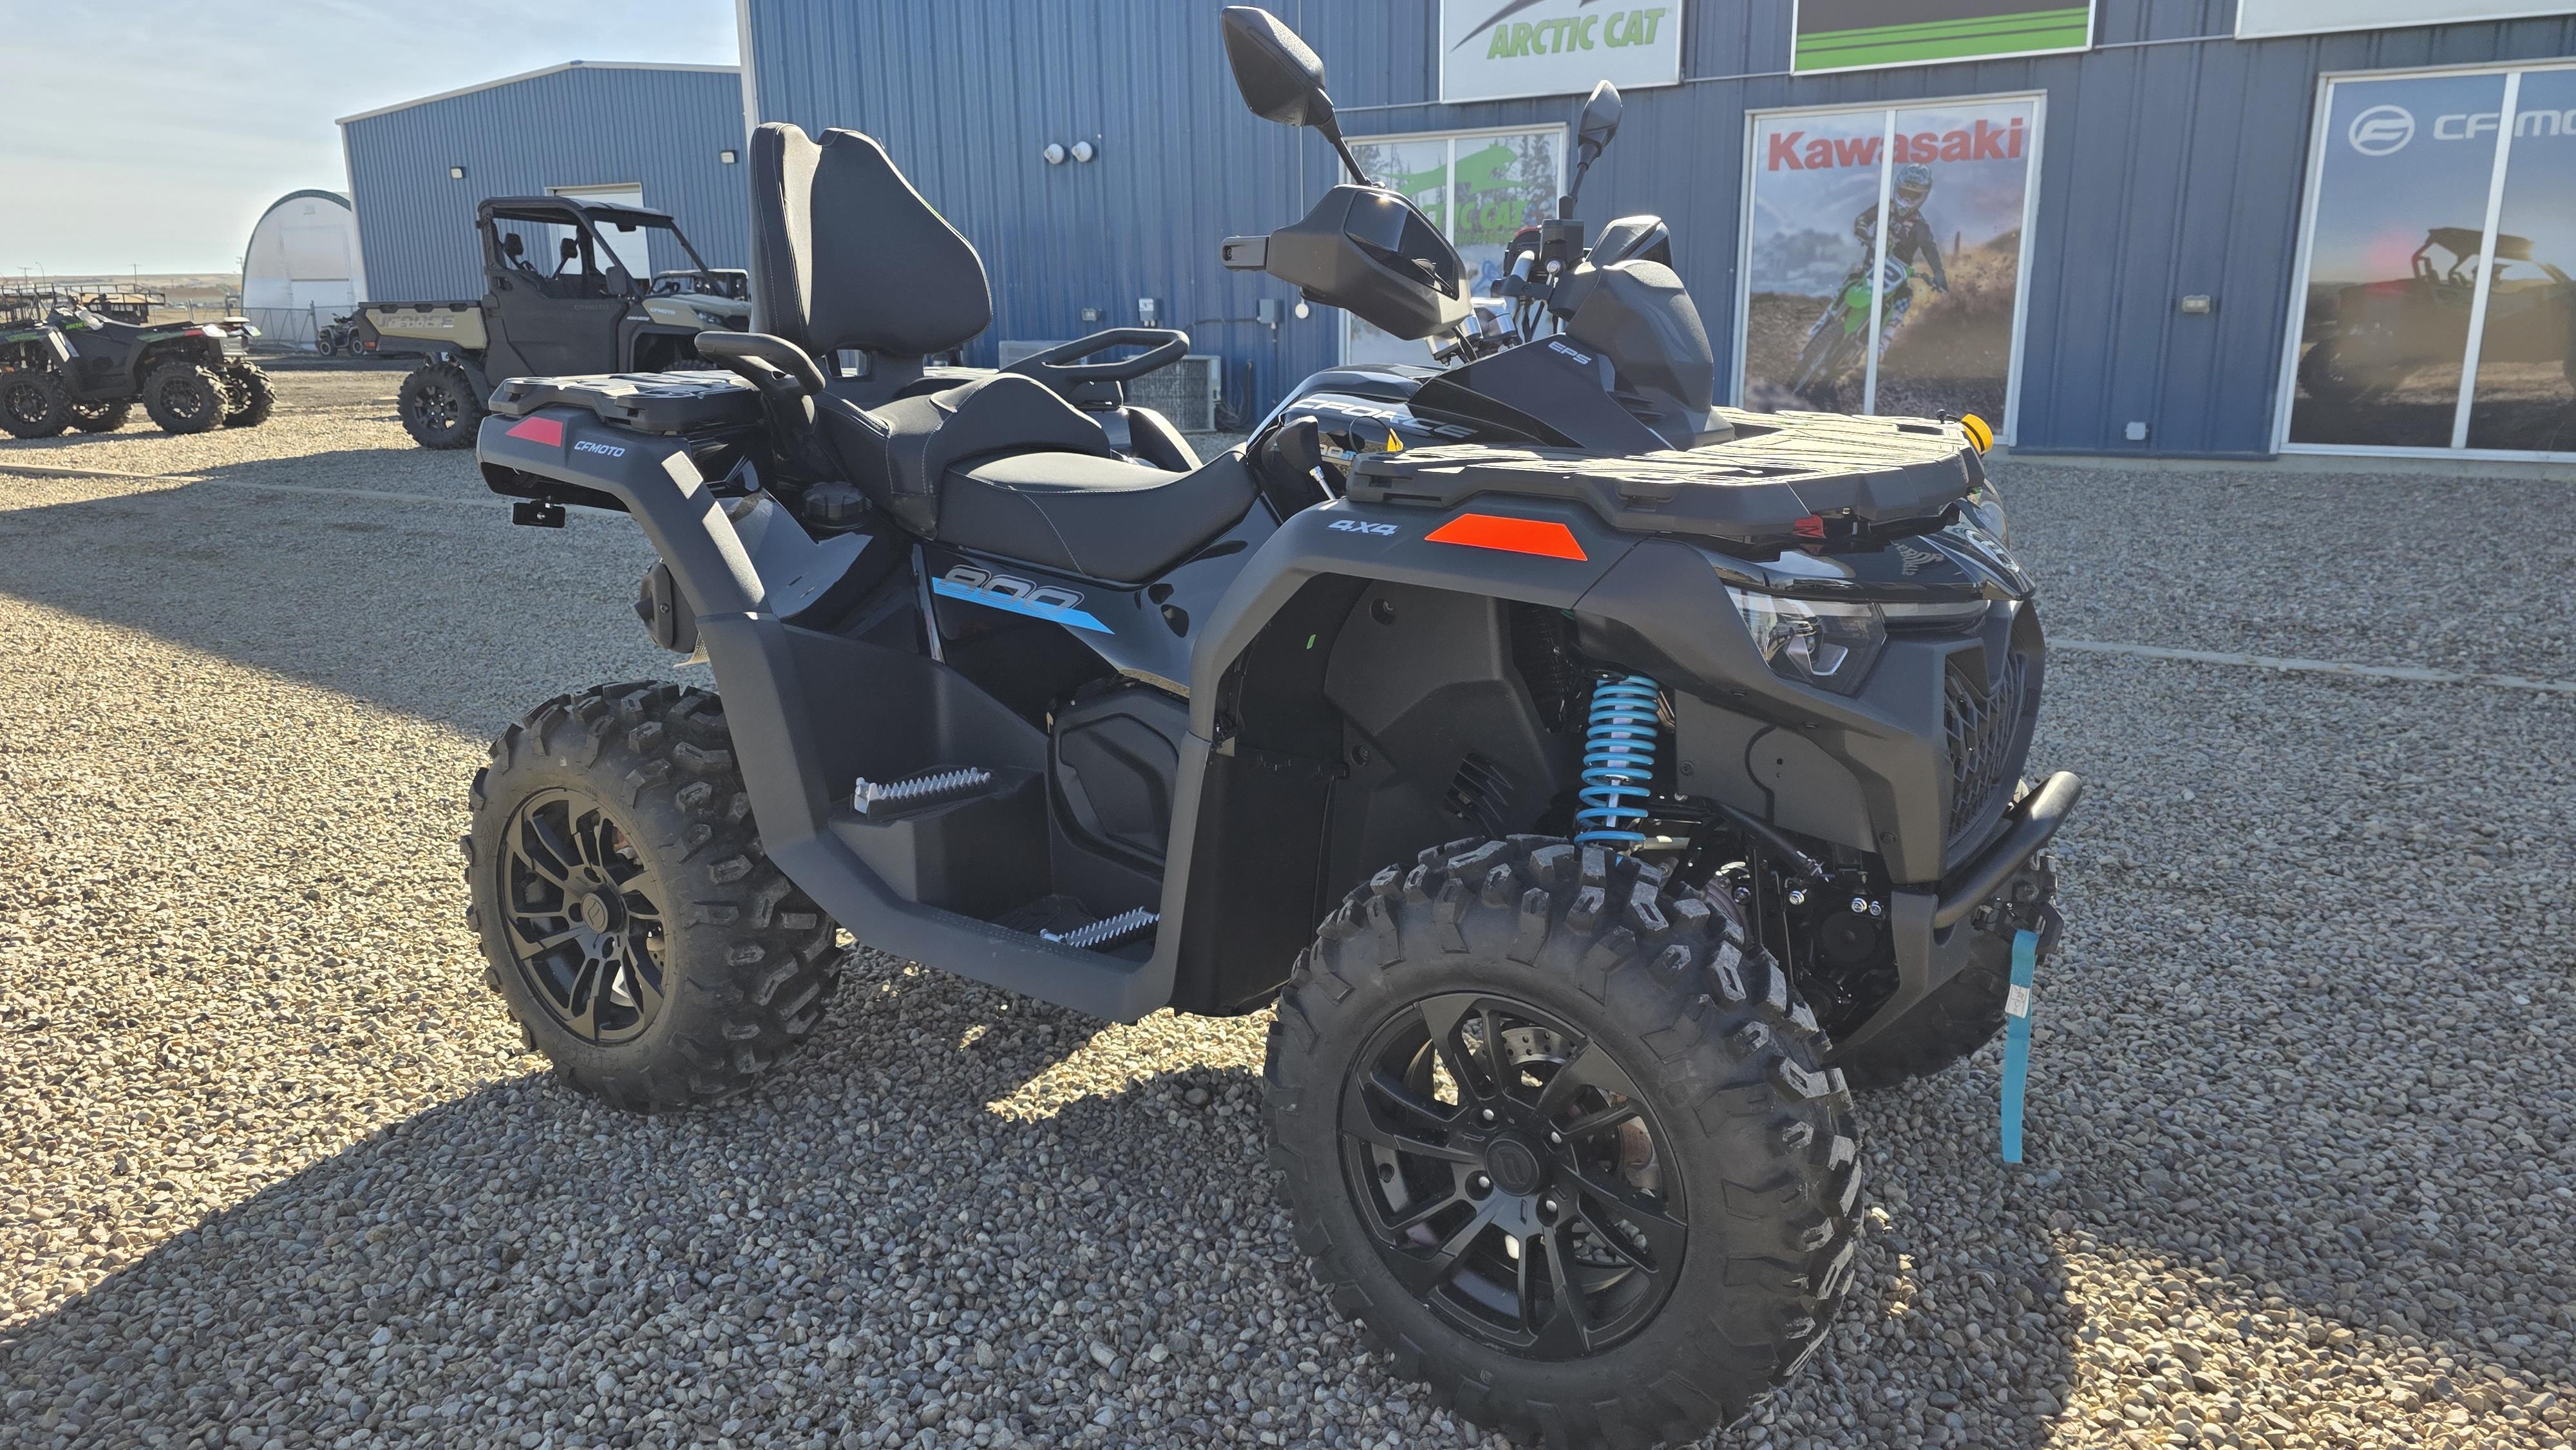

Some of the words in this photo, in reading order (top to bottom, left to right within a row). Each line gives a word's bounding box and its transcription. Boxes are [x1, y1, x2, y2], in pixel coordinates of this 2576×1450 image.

[1486, 15, 1598, 59] ARCTIC
[1604, 8, 1666, 48] CAT
[1768, 117, 2023, 171] Kawasaki
[1481, 199, 1528, 229] CAT
[1548, 341, 1592, 364] EPS
[1288, 398, 1479, 438] CFORCE
[574, 440, 625, 457] CFMOTO
[937, 565, 1085, 616] 800
